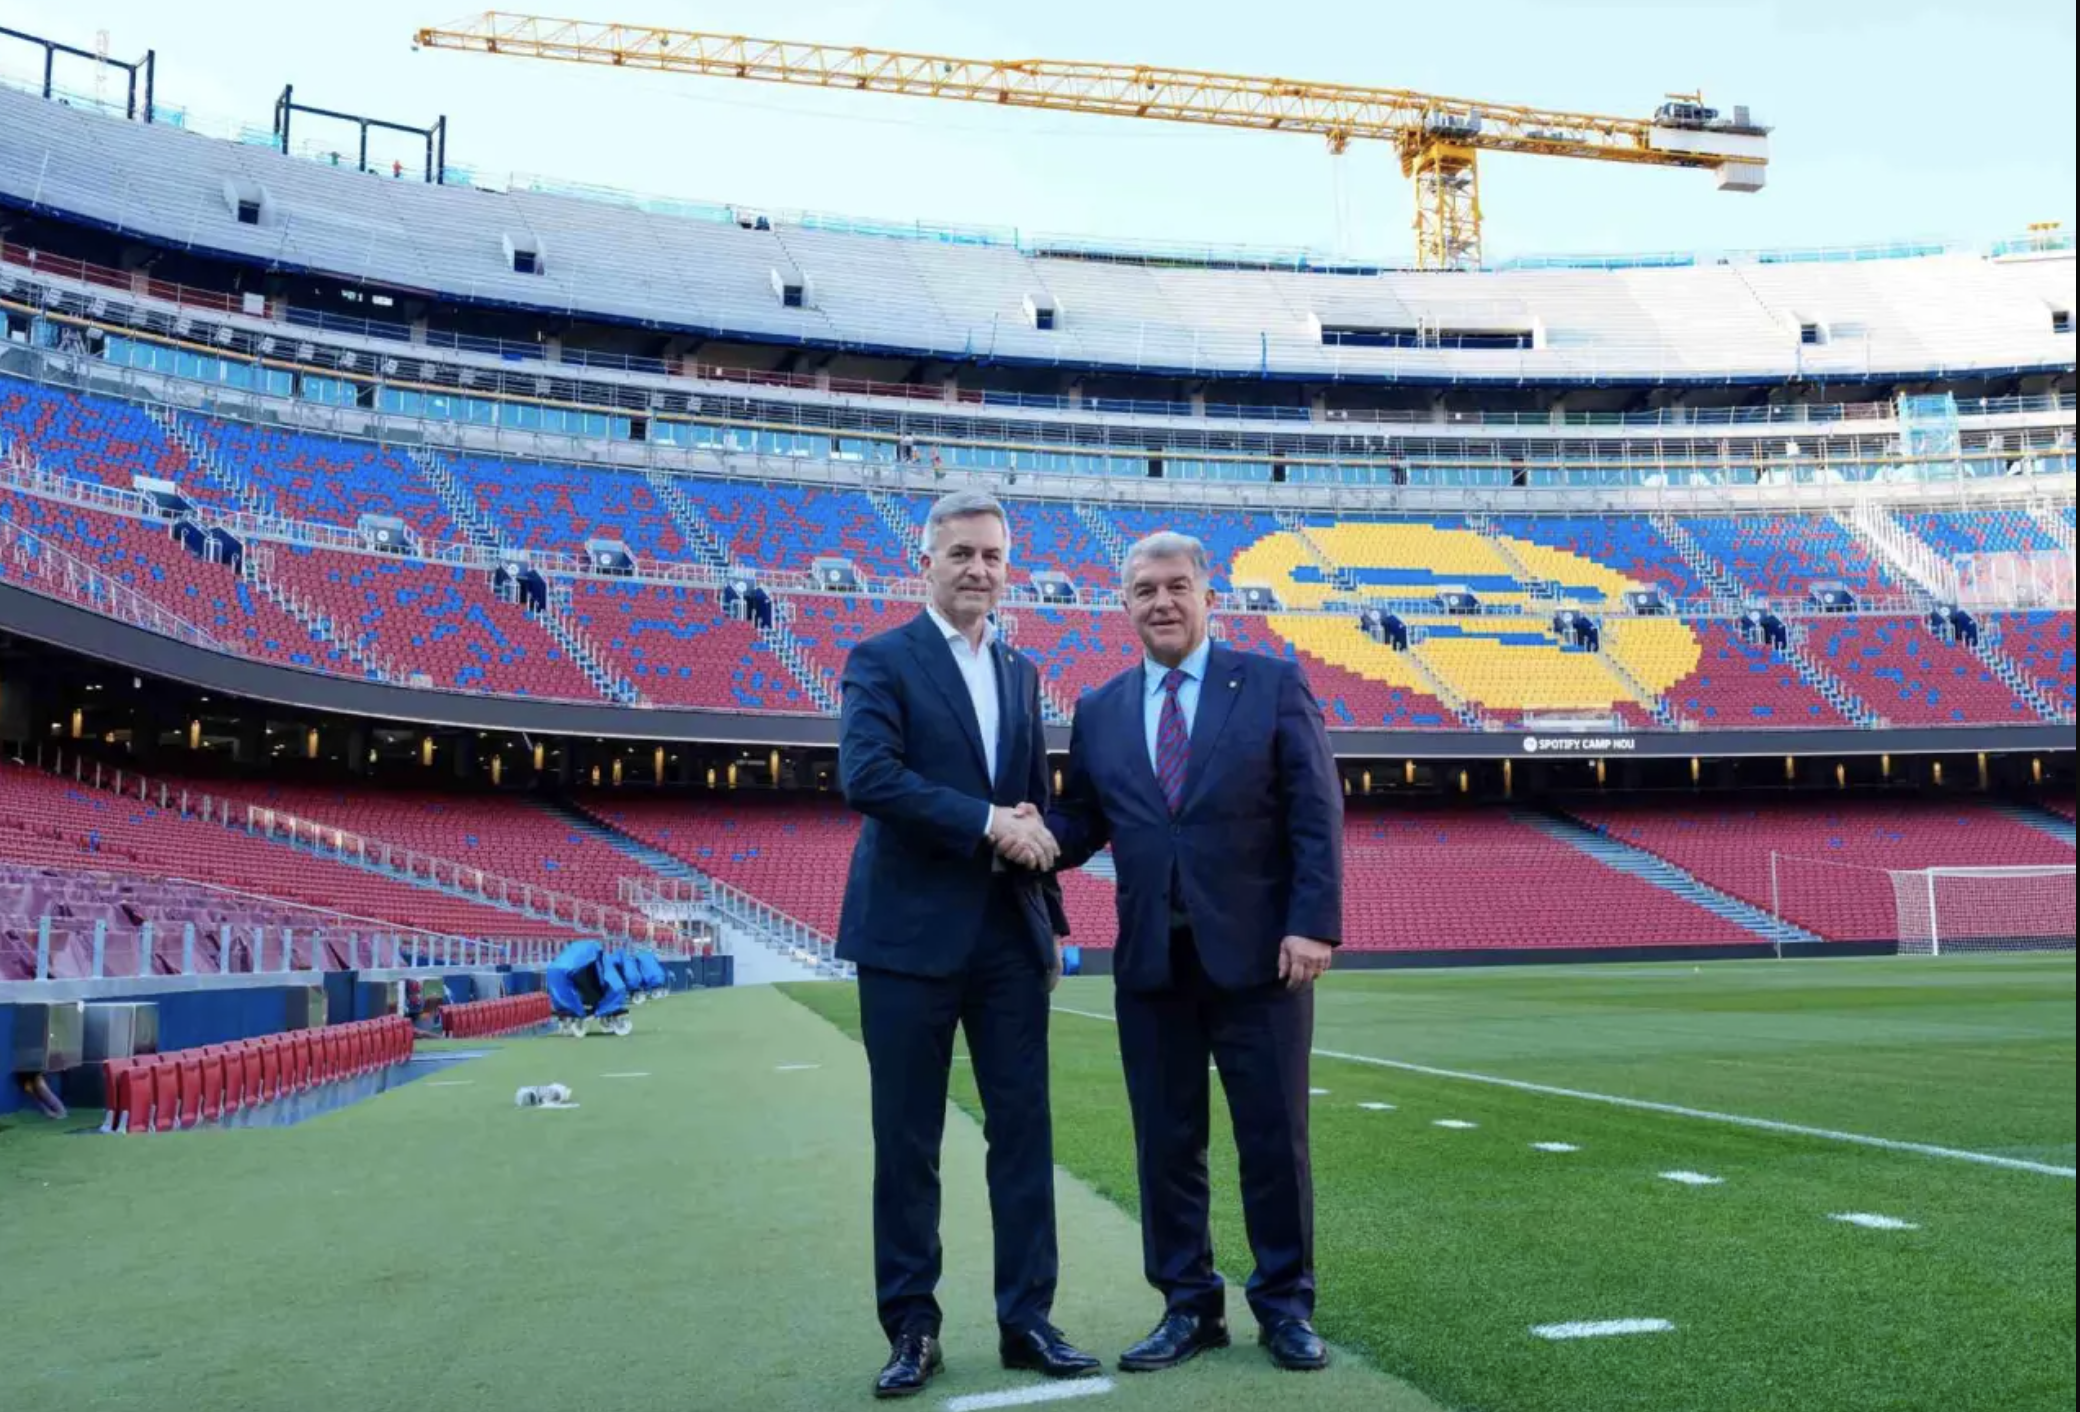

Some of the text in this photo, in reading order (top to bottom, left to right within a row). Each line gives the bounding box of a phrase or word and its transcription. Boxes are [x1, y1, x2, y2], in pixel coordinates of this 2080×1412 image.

[1539, 739, 1635, 749] SPOTIFY CAMP NOU
